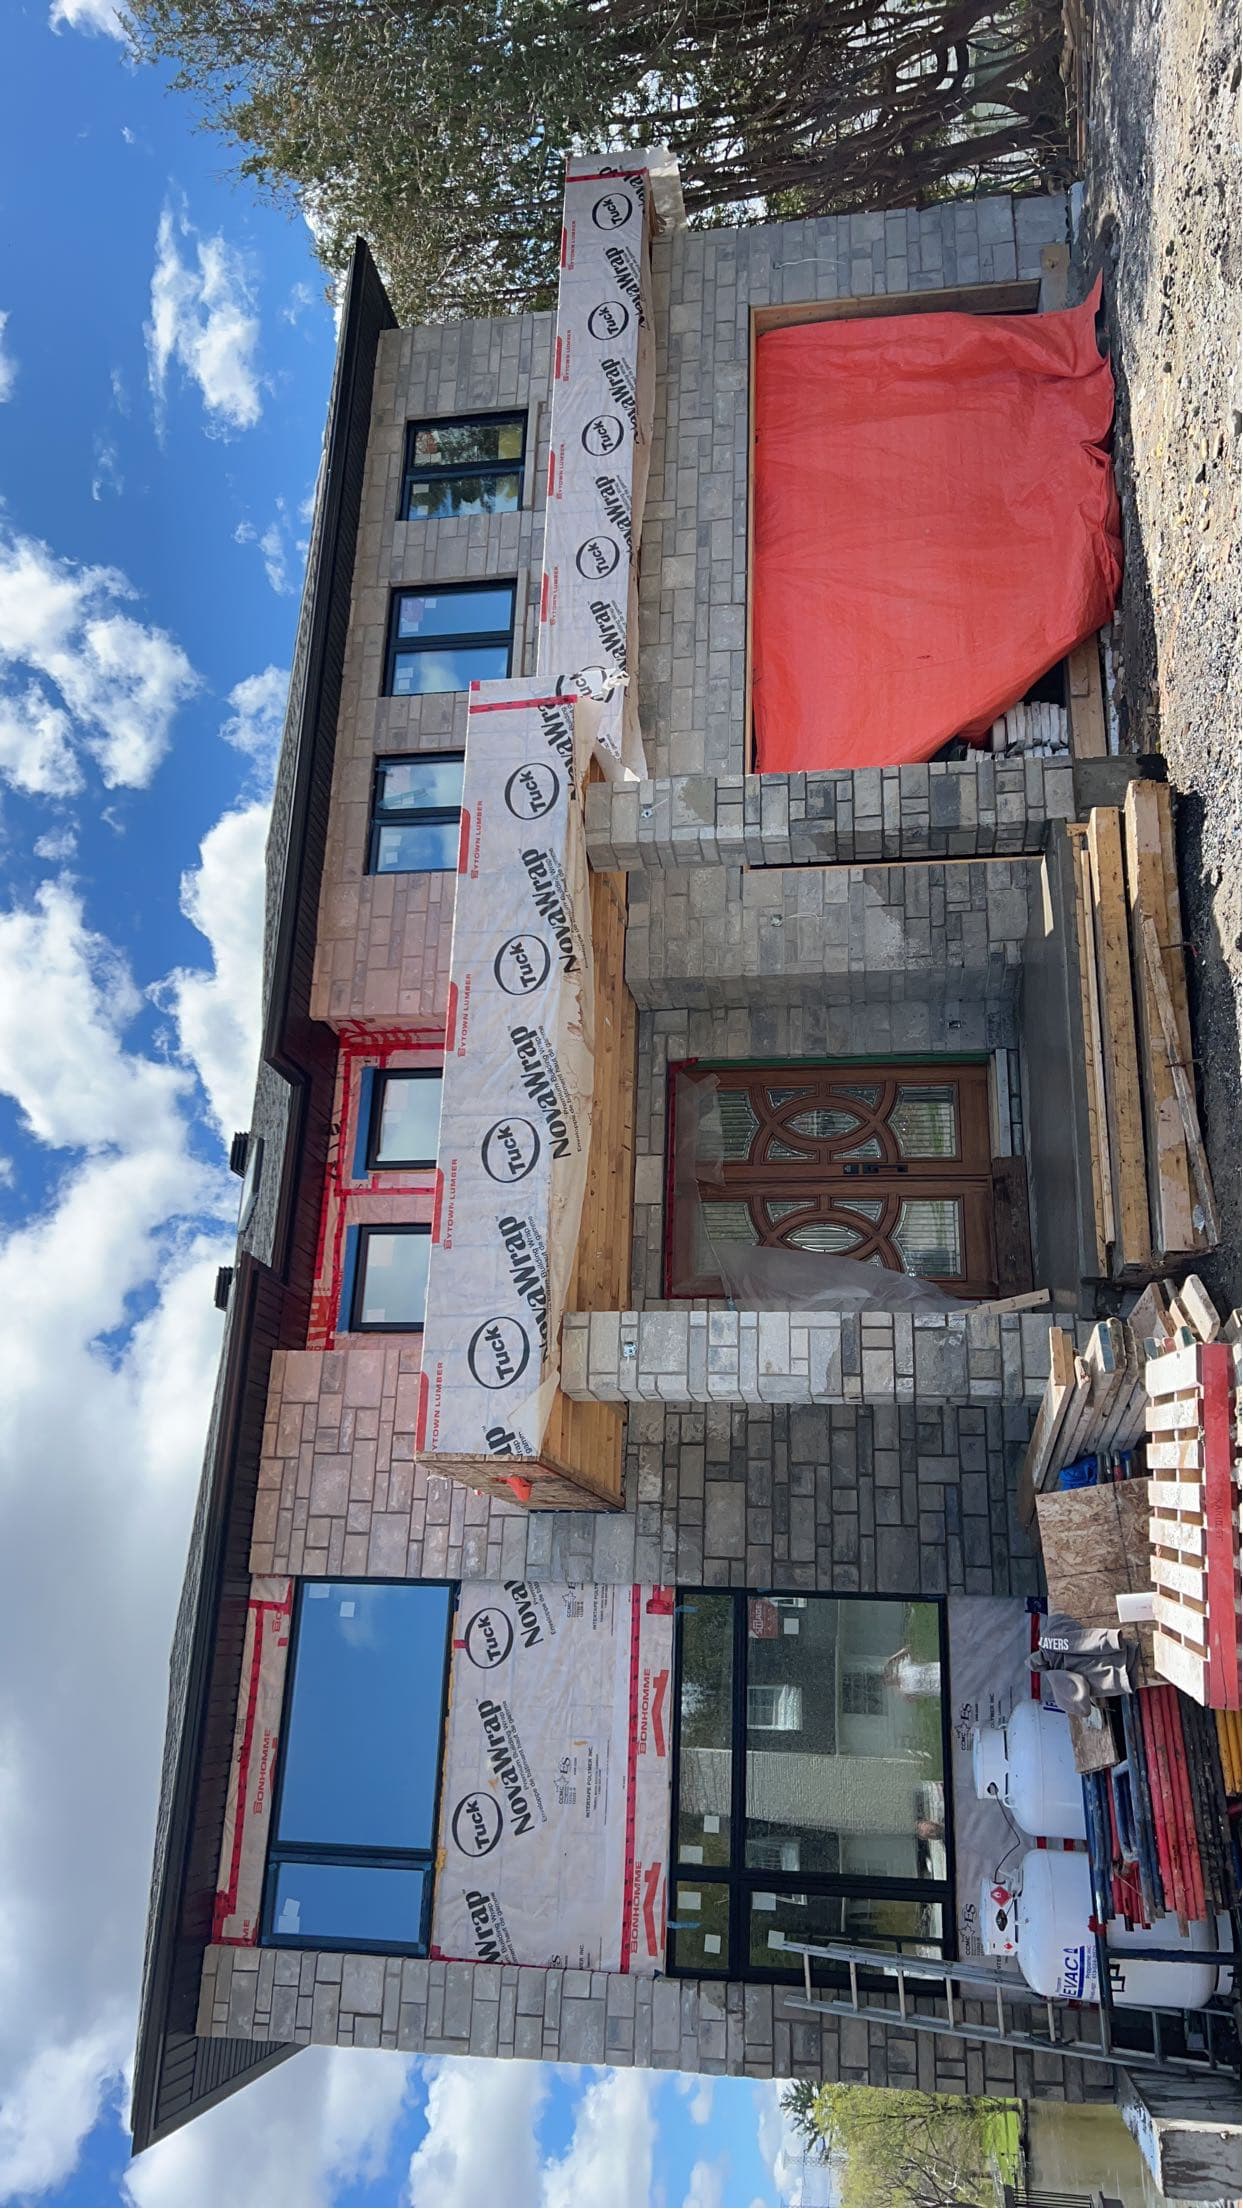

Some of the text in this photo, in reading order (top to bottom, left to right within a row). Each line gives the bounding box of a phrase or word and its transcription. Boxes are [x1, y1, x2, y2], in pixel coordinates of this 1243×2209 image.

[602, 198, 623, 224] Tuck
[598, 306, 620, 334] Tuck
[592, 420, 614, 451] Tuck
[587, 542, 610, 574] Tuck
[518, 770, 546, 812] Tuck
[471, 800, 483, 879] BYTOWN LUMBER
[520, 848, 581, 973] NovaWrap
[509, 942, 537, 988] Tuck
[457, 974, 472, 1056] BYTOWN LUMBER
[540, 1054, 558, 1082] Building
[510, 1026, 572, 1159] NovaWrap
[553, 1084, 569, 1114] Premium
[566, 1104, 576, 1114] de
[496, 1125, 526, 1174] Tuck
[570, 1115, 582, 1152] Enveloppe
[444, 1158, 458, 1250] BYTOWN LUMBER
[524, 1228, 538, 1248] Wrap
[484, 1326, 515, 1380] Tuck
[434, 1362, 443, 1406] LUMBER
[478, 1615, 501, 1662] Tuck
[502, 1700, 516, 1724] gamme
[510, 1724, 518, 1734] de
[636, 1668, 650, 1755] BONHOMME
[499, 1711, 530, 1790] Premium Building Wrap
[513, 1734, 523, 1749] haut
[252, 1728, 270, 1814] BONHOMME
[477, 1700, 535, 1836] NovaWrap
[528, 1778, 536, 1788] de
[466, 1800, 490, 1850] Tuck
[532, 1788, 548, 1822] Enveloppe
[487, 1902, 508, 1954] Building Wrap
